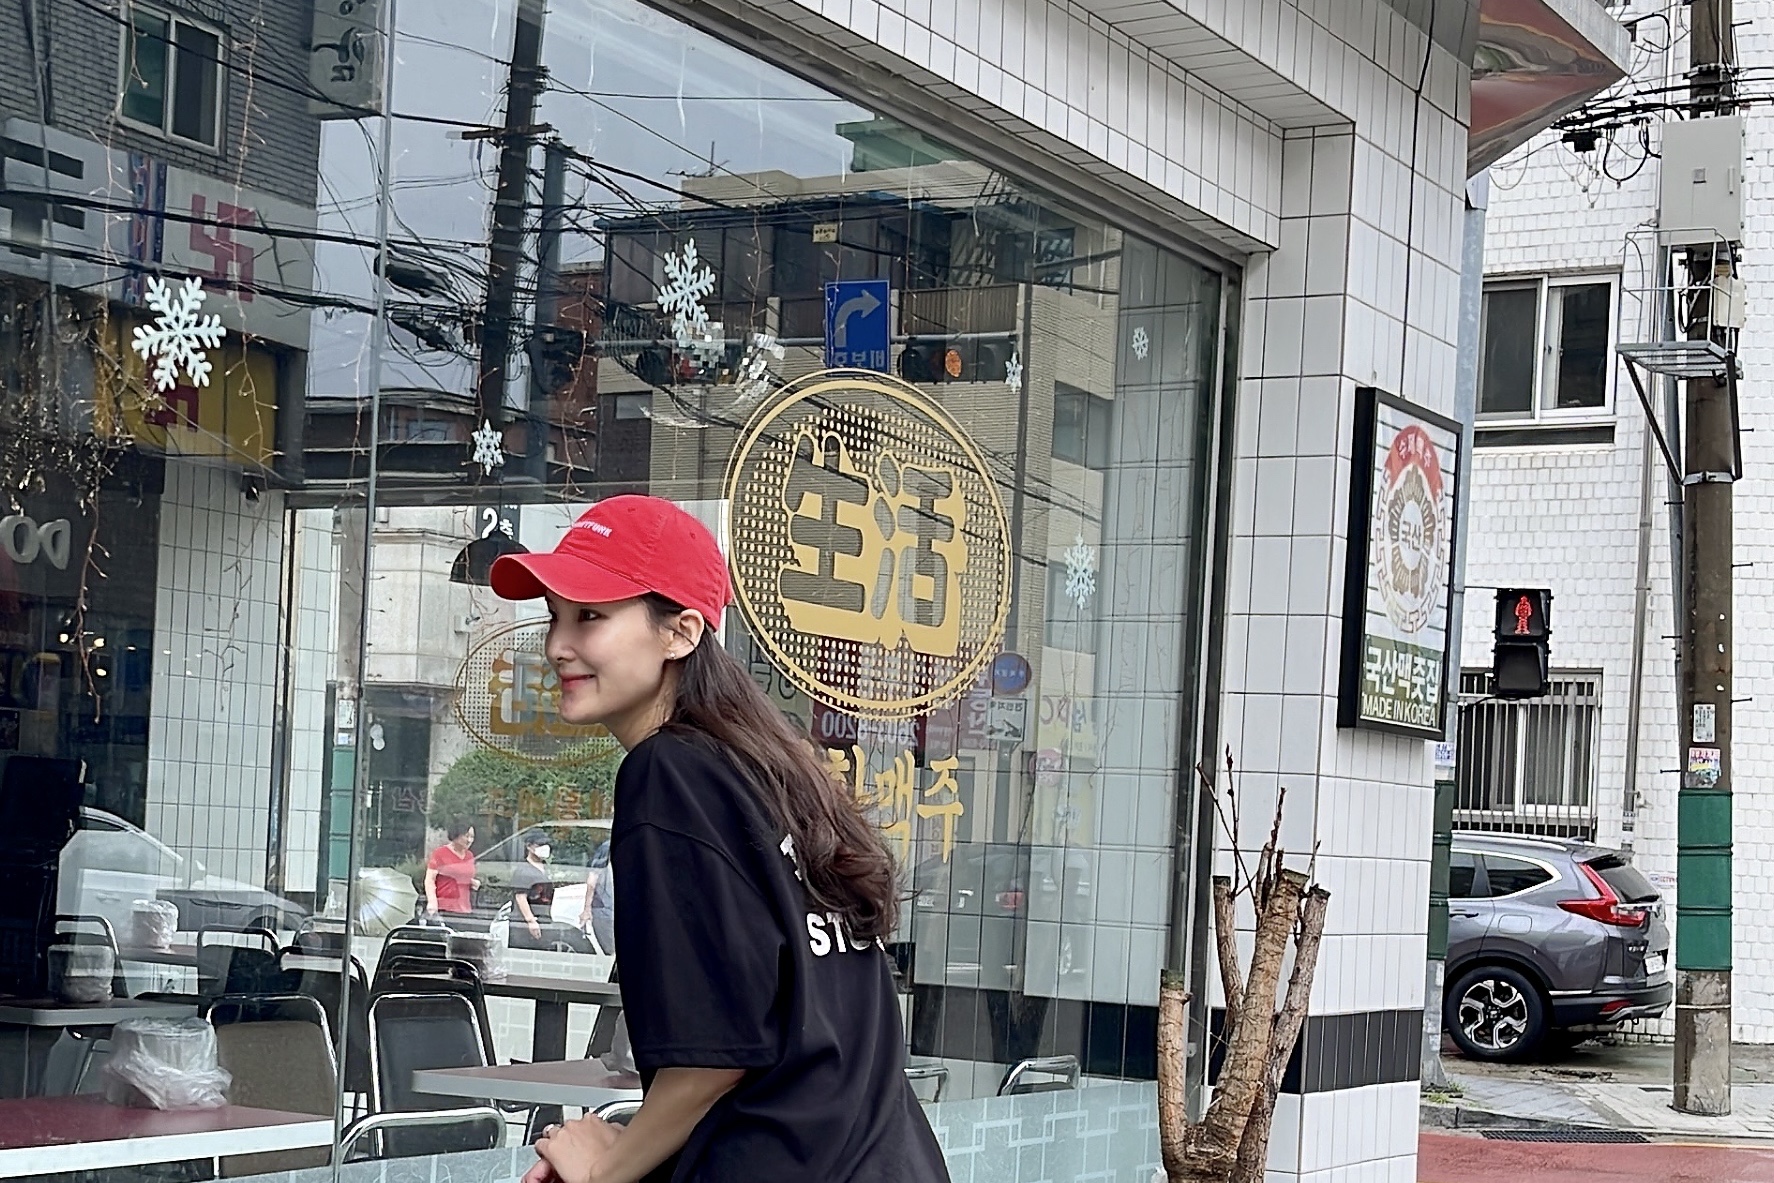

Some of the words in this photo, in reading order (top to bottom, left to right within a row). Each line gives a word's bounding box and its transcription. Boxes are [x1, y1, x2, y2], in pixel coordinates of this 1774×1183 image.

[1401, 520, 1422, 551] 국산
[1362, 694, 1393, 719] MADE
[1393, 700, 1404, 721] IN
[1404, 702, 1436, 727] KOREA
[806, 911, 885, 957] ST
